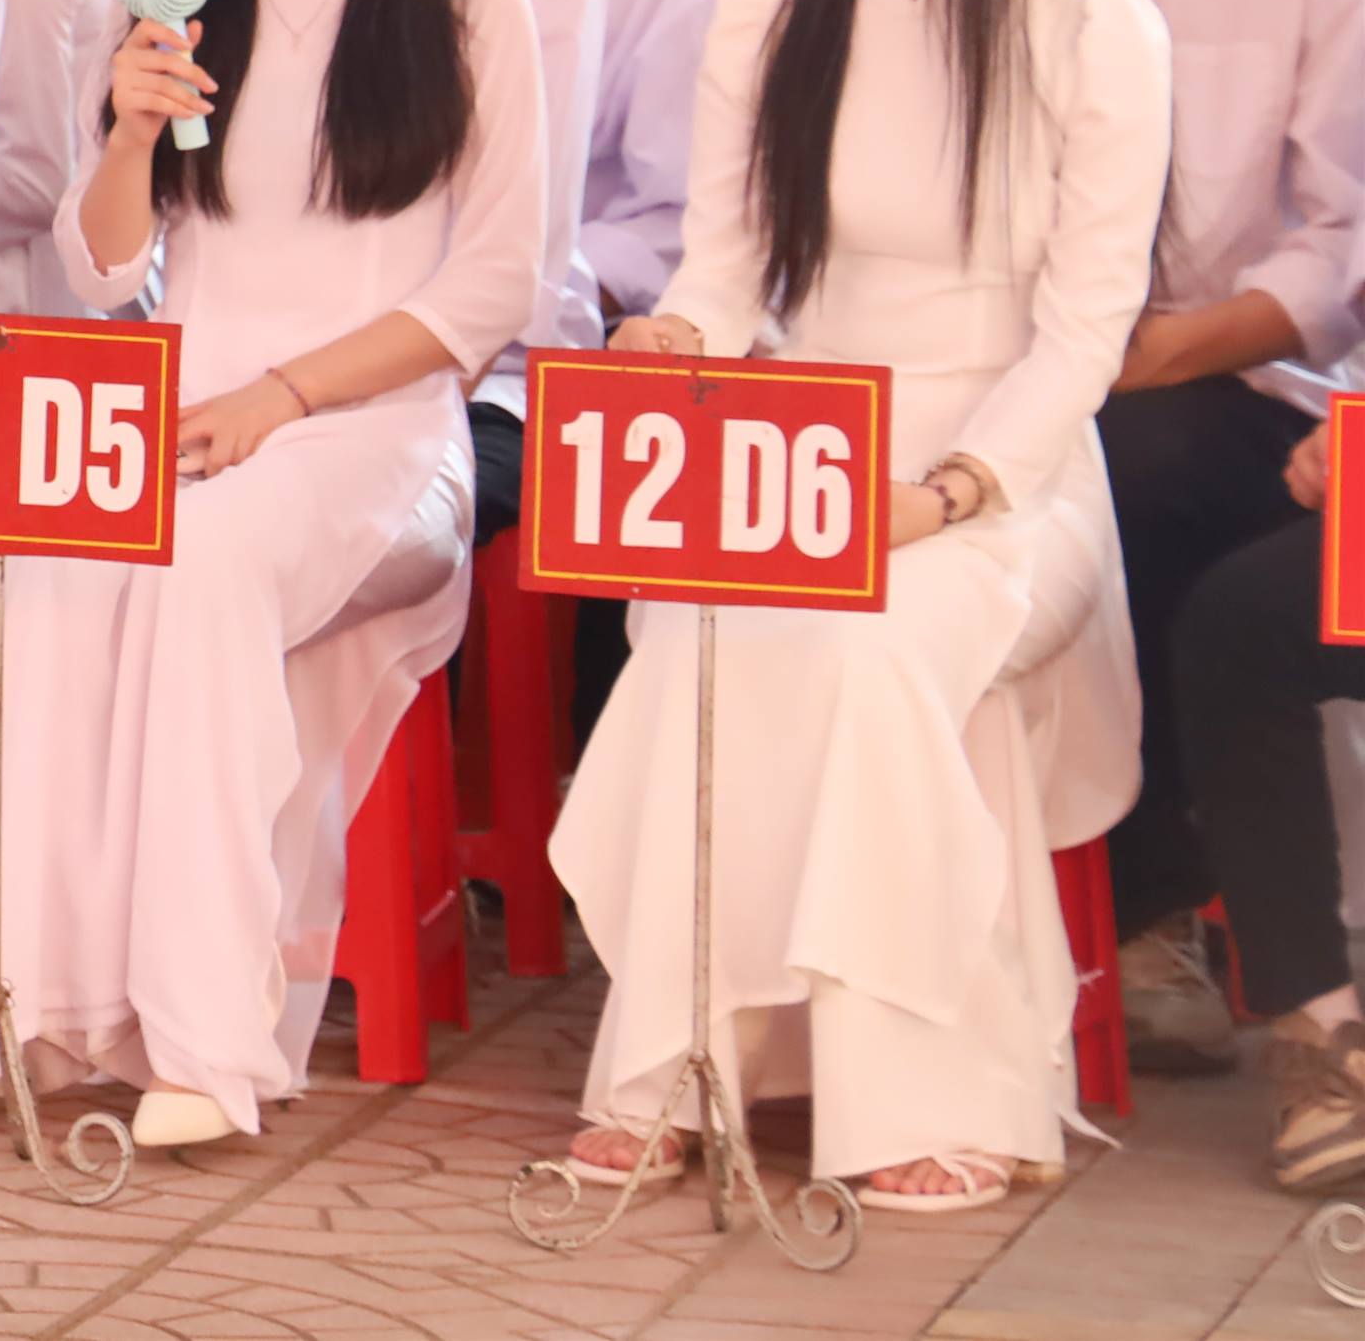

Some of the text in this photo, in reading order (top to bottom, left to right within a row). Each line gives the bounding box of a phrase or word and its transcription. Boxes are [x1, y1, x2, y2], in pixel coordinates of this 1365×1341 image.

[19, 377, 145, 512] D5
[561, 411, 852, 559] 12 D6
